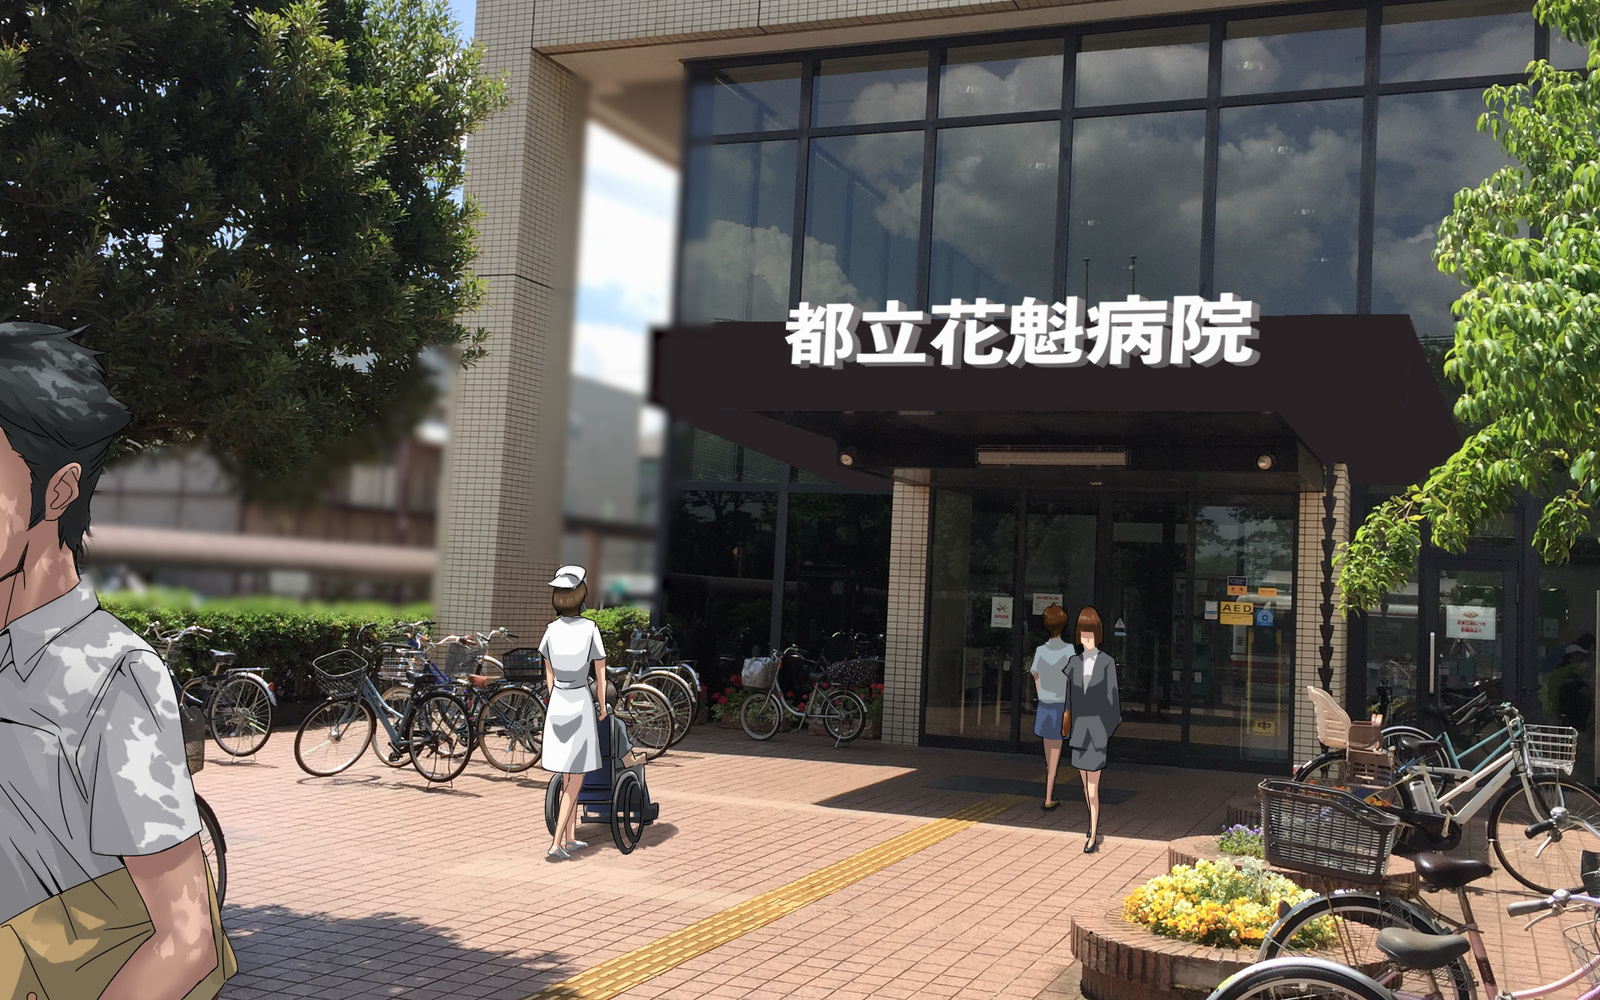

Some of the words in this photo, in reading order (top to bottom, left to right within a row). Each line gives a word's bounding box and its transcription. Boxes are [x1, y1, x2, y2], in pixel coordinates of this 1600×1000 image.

[785, 292, 1256, 367] 都立花魁病院
[1222, 604, 1252, 613] AED
